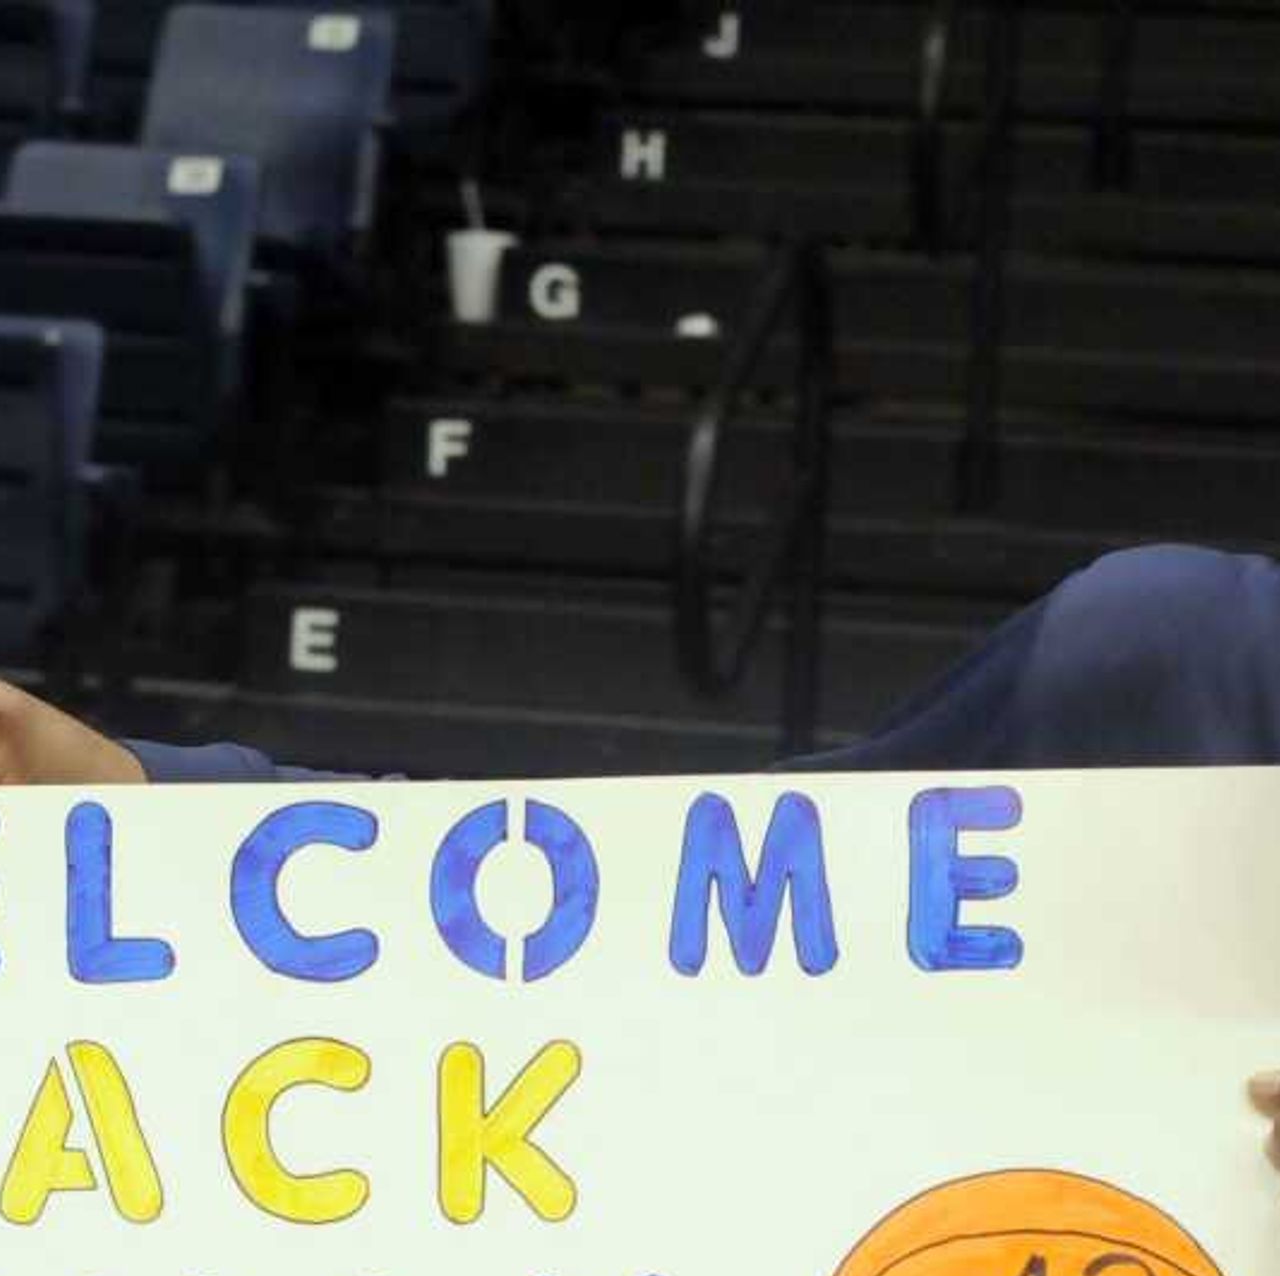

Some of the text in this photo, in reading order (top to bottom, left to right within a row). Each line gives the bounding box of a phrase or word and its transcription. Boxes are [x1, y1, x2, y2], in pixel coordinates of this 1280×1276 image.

[704, 13, 739, 58] J
[620, 131, 666, 179] H
[529, 263, 581, 319] G
[428, 418, 472, 477] F
[289, 607, 339, 672] E
